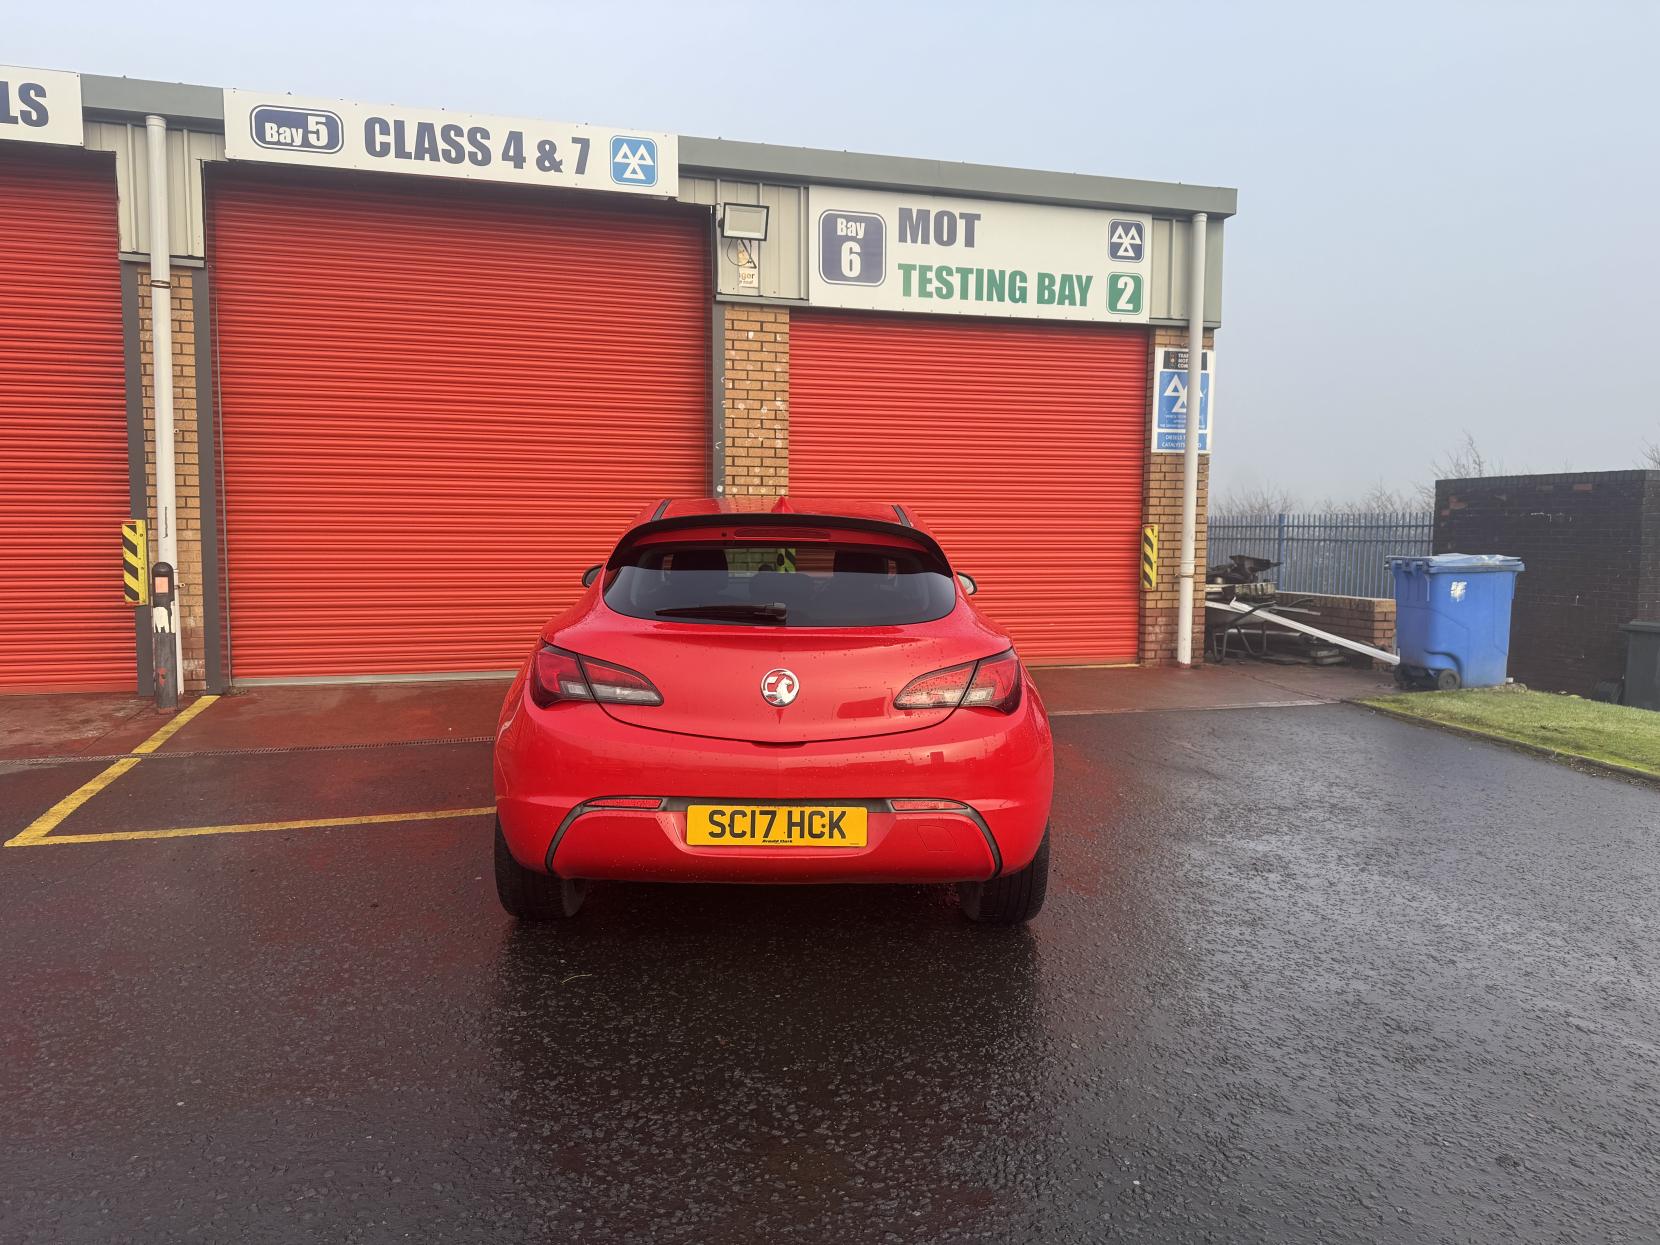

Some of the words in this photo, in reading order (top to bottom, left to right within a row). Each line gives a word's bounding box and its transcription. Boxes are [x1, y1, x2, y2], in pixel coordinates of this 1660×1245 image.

[264, 122, 303, 147] Bay
[307, 115, 329, 148] 5
[364, 116, 492, 166] CLASS
[501, 131, 527, 169] 4
[536, 139, 564, 173] &
[571, 137, 591, 175] 7
[836, 218, 865, 239] Bay
[898, 207, 982, 248] MOT
[840, 241, 862, 278] 6
[897, 263, 1028, 302] TESTING
[1036, 271, 1094, 307] BAY
[1116, 276, 1135, 311] 2
[708, 809, 777, 838] SC17
[786, 810, 847, 839] HCK
